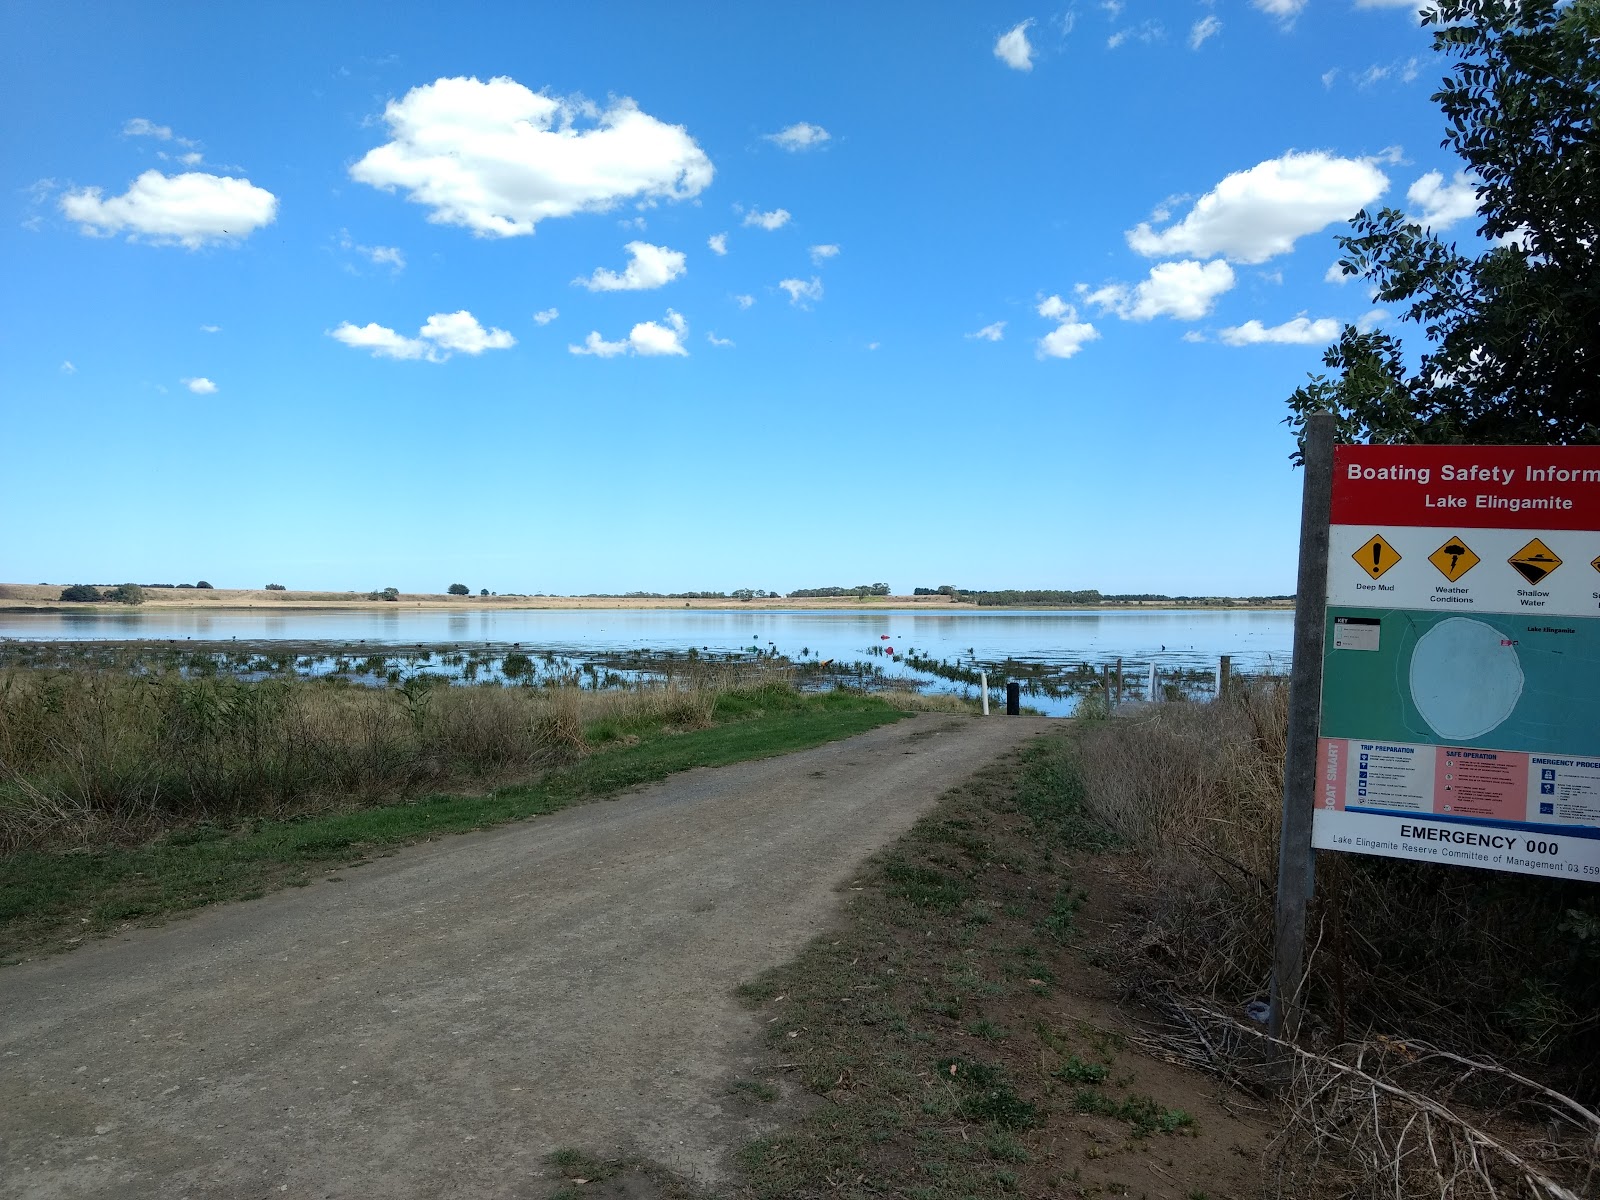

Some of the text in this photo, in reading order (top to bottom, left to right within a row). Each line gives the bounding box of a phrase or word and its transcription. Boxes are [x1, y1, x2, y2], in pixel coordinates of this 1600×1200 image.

[1347, 463, 1430, 485] Boating
[1440, 464, 1515, 486] Safety
[1425, 494, 1573, 512] Lake Elingamite
[1356, 583, 1395, 592] Deep Mud
[1435, 586, 1470, 594] Weather
[1517, 589, 1550, 597] Shallow
[1429, 595, 1474, 604] Conditions
[1520, 599, 1546, 607] Water
[1375, 745, 1415, 754] PREPARATION
[1446, 750, 1497, 760] SAFE OPERATION
[1327, 743, 1339, 781] SMART
[1532, 757, 1574, 767] EMERGENCY
[1400, 824, 1559, 856] EMERGENCY 000
[1332, 834, 1352, 845] Lake
[1356, 837, 1398, 850] Elingamite
[1402, 842, 1438, 855] Reserve
[1441, 847, 1489, 862] Committee
[1493, 854, 1502, 863] of
[1506, 856, 1563, 871] Management
[1583, 865, 1600, 875] 559
